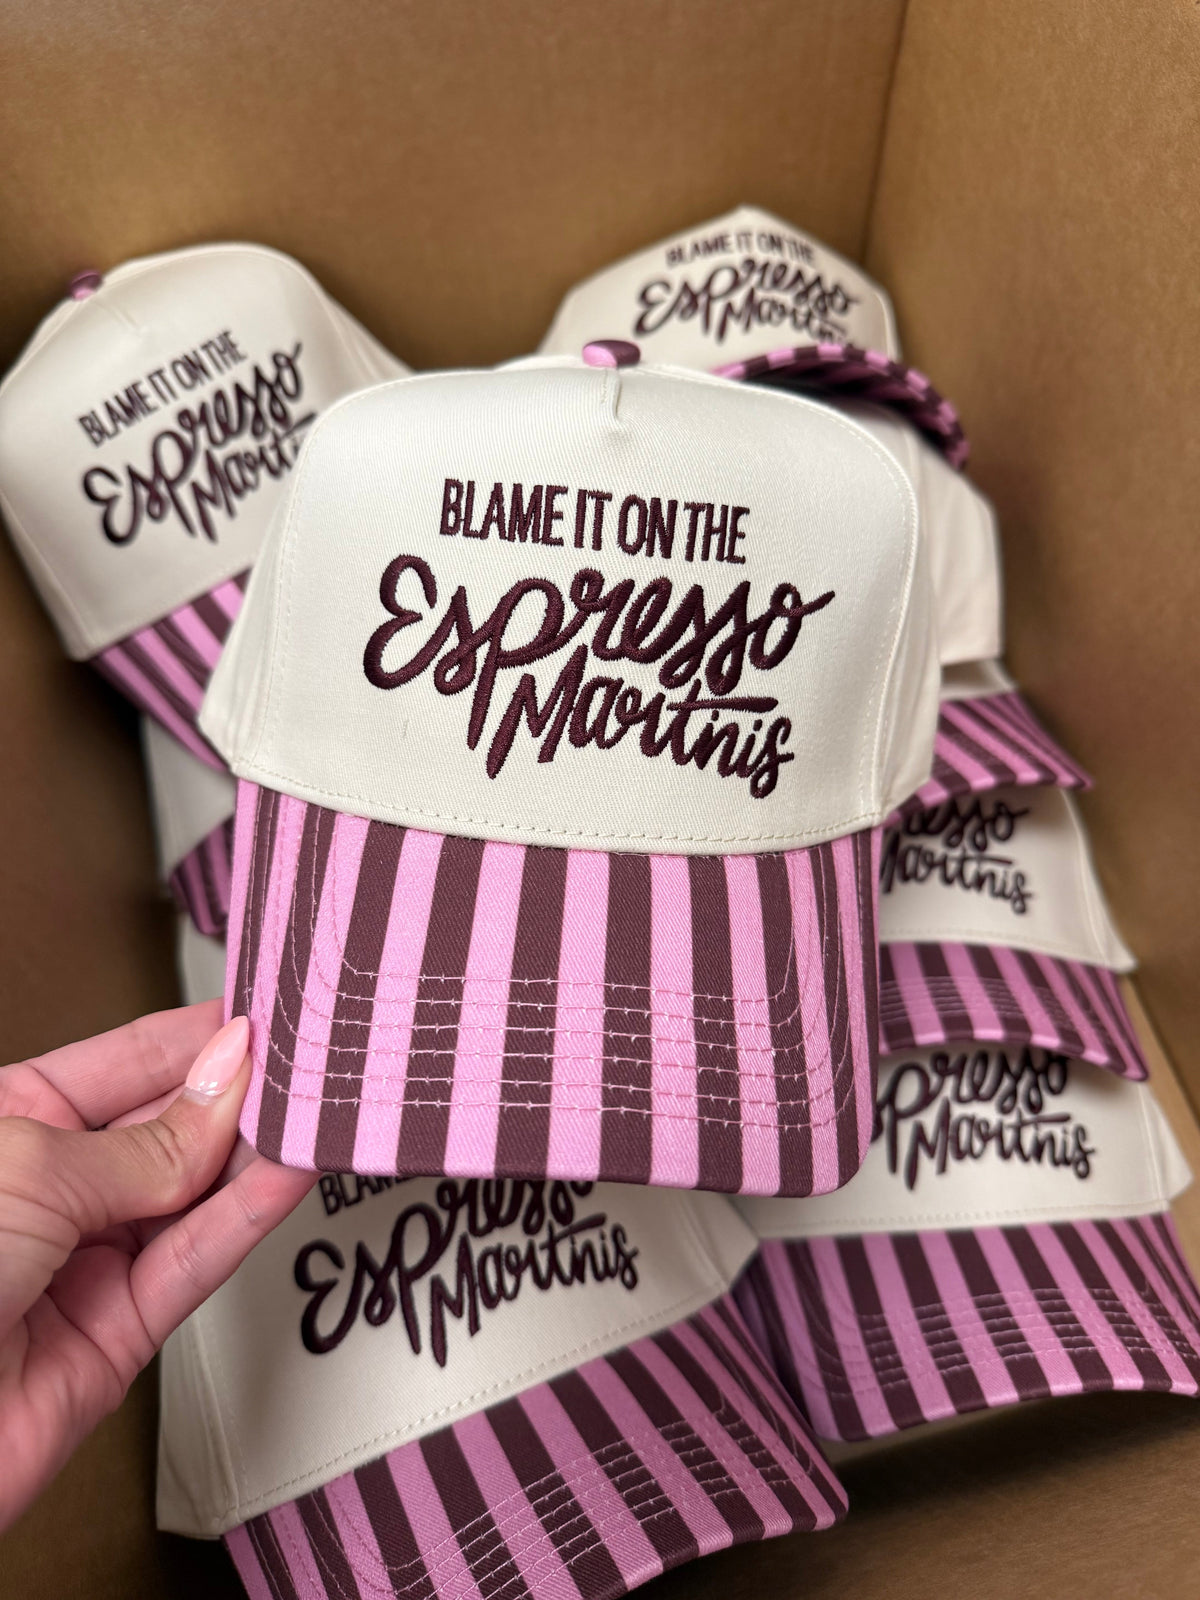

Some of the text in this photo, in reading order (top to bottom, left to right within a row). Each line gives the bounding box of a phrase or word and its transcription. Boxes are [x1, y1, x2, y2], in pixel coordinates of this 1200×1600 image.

[666, 231, 815, 267] BLAME IT ON THE
[78, 329, 248, 447] BLAME IT ON THE
[439, 478, 750, 564] BLAME IT ON THE
[485, 644, 795, 799] Martinis
[903, 1096, 1096, 1191] Martinis
[318, 1173, 421, 1216] BLA
[430, 1212, 640, 1368] Martinis
